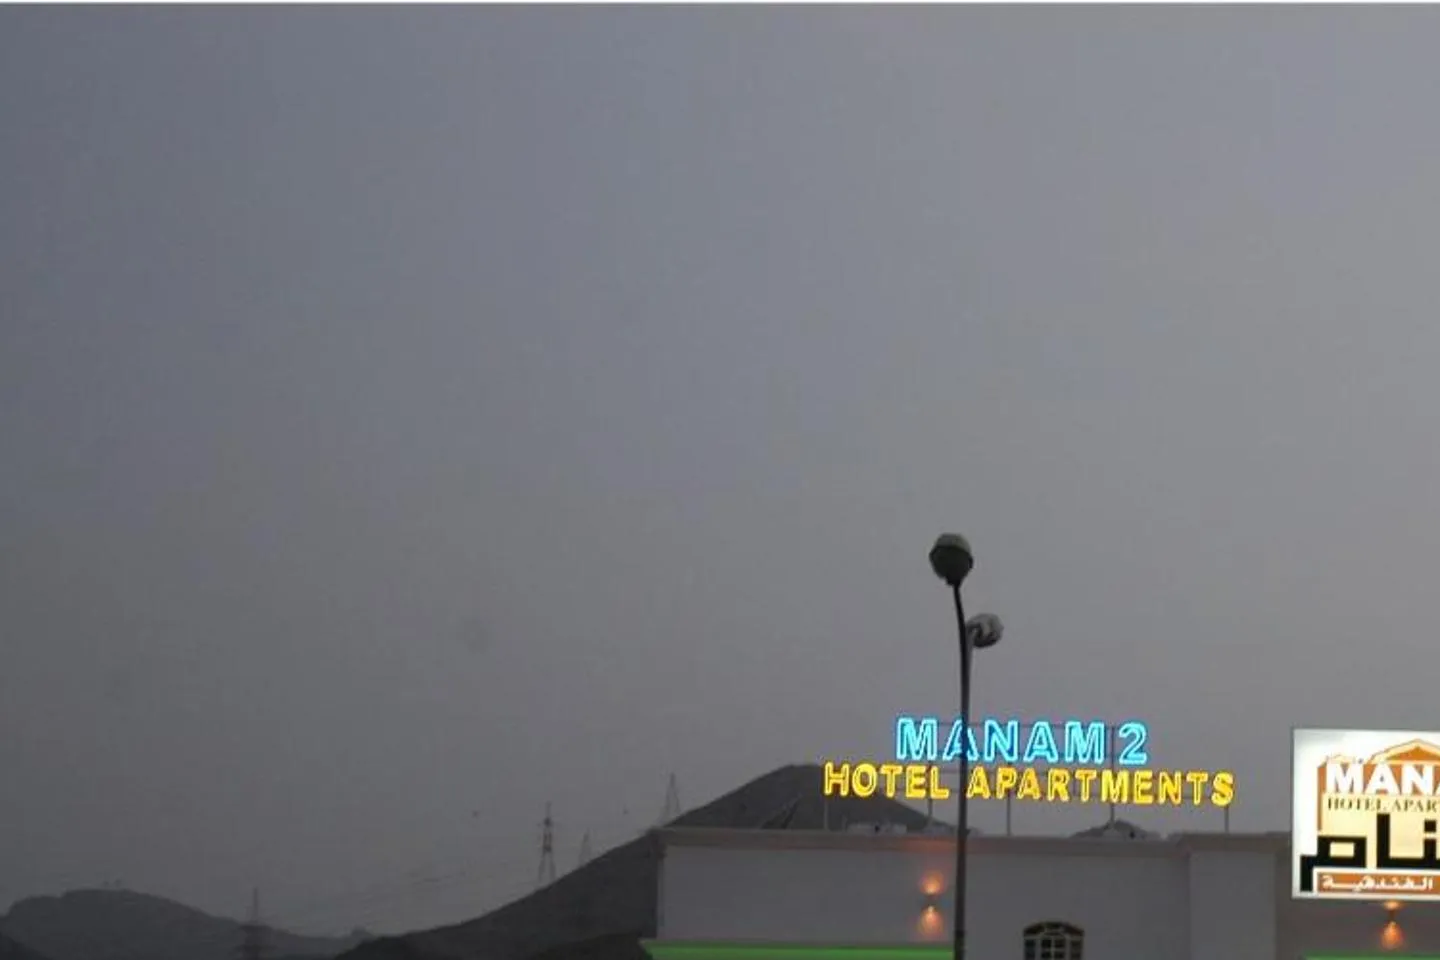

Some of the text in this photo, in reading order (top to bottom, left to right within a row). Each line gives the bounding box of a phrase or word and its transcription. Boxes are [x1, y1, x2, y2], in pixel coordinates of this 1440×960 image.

[896, 717, 1149, 765] MANAM 2
[823, 762, 1237, 806] HOTEL APARTMENTS
[1327, 797, 1387, 812] HOTEL
